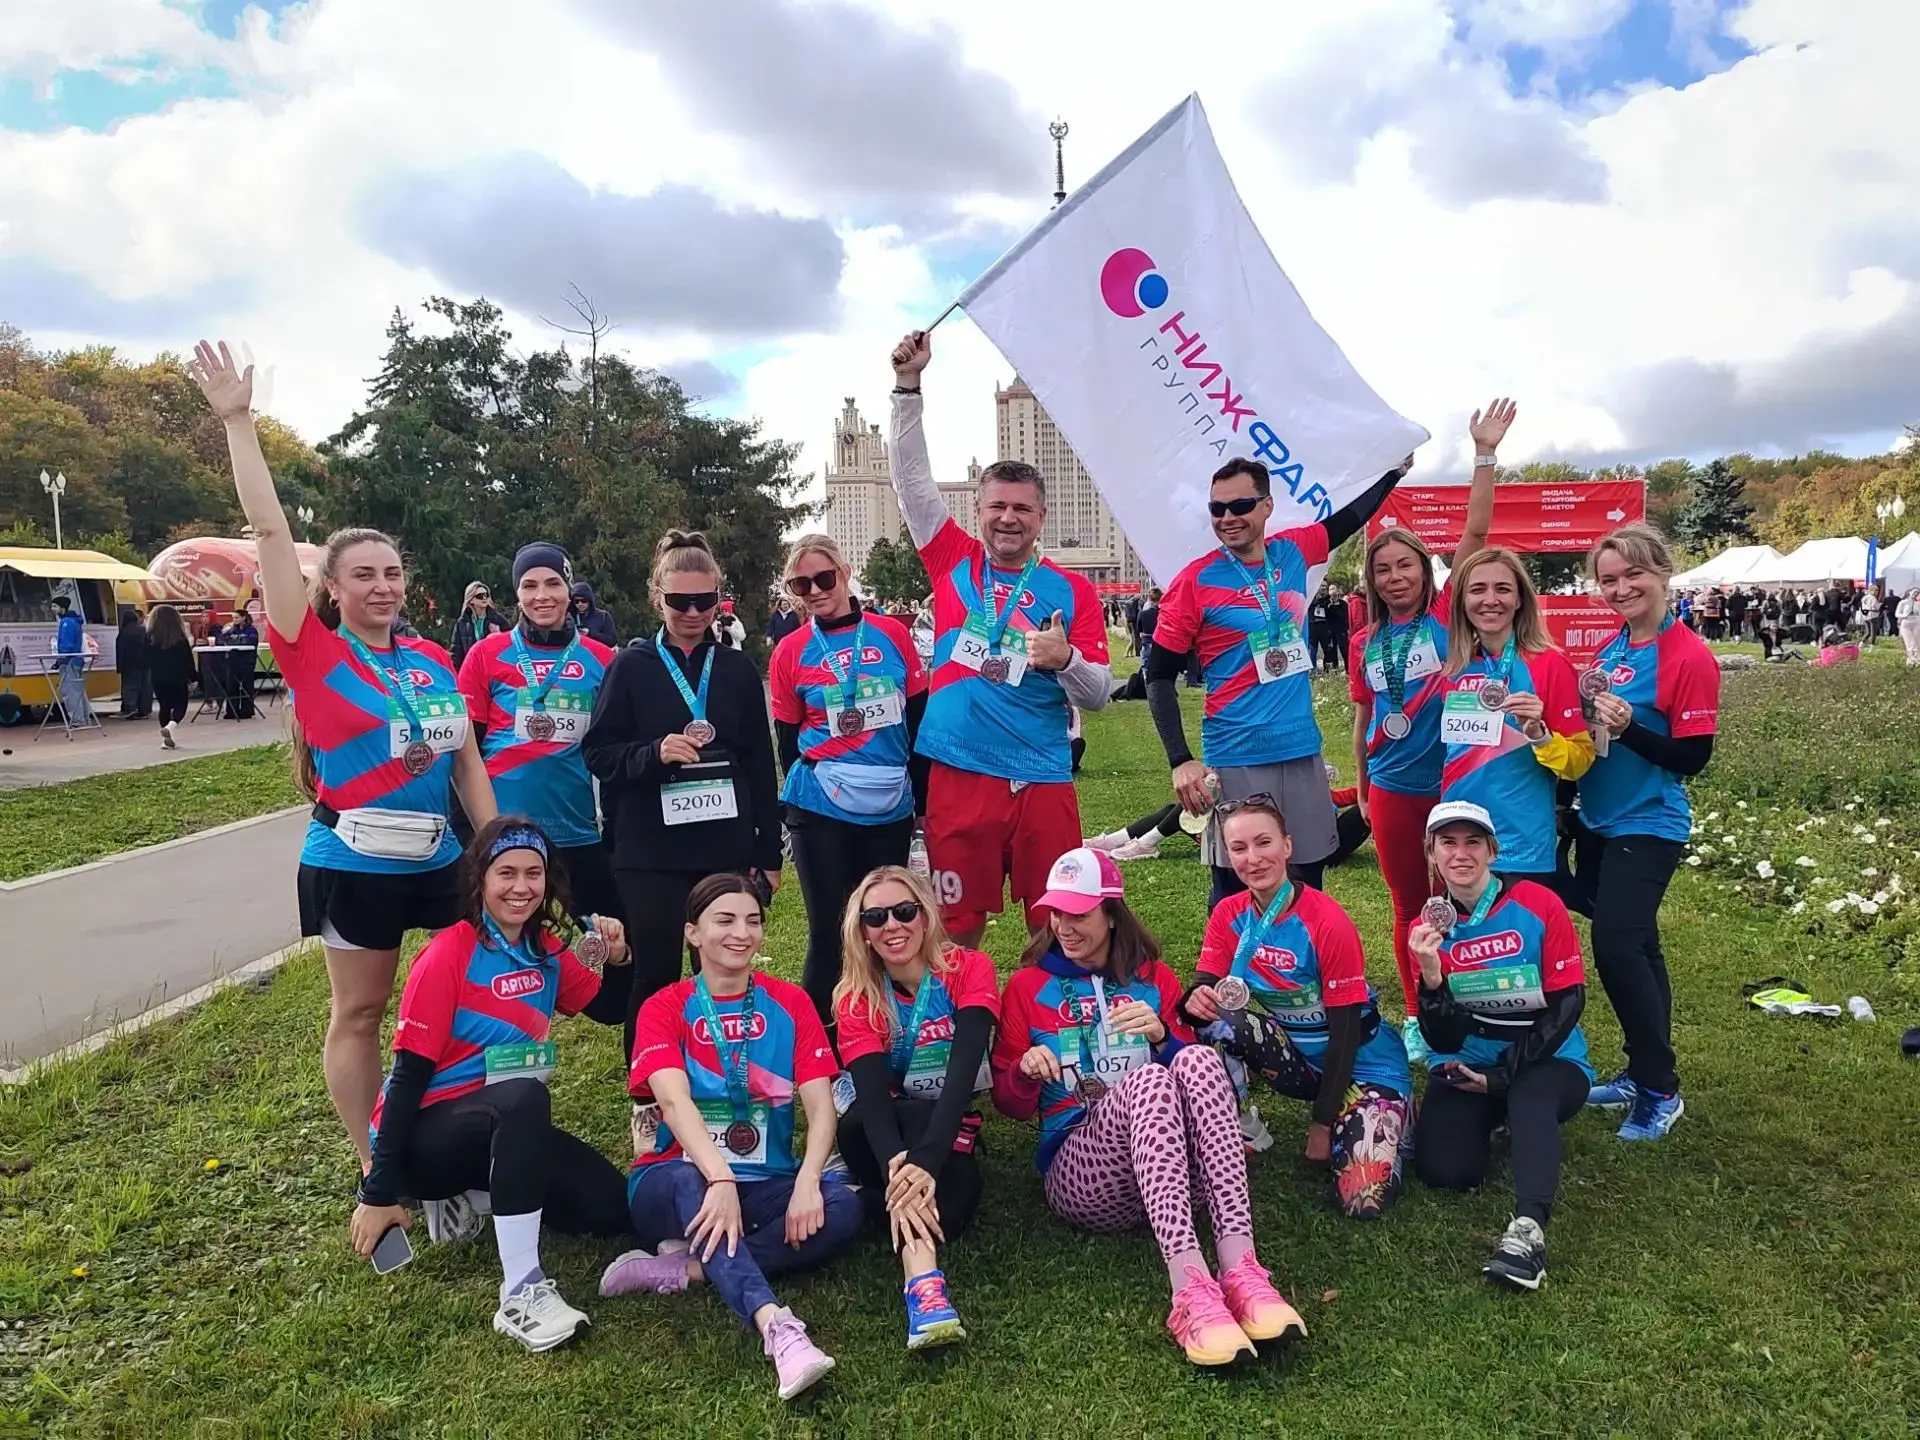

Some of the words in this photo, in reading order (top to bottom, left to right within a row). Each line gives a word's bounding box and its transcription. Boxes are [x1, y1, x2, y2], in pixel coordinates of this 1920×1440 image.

[1139, 336, 1229, 457] ГРУППА
[1541, 538, 1576, 546] ГОРЯЧИЙ
[1576, 537, 1593, 545] ЧАЙ
[398, 724, 454, 743] 5066
[1446, 718, 1489, 733] 52064
[671, 793, 722, 812] 52070
[1459, 935, 1518, 961] ARTRA
[1465, 997, 1527, 1010] 52049
[911, 1076, 946, 1092] 520
